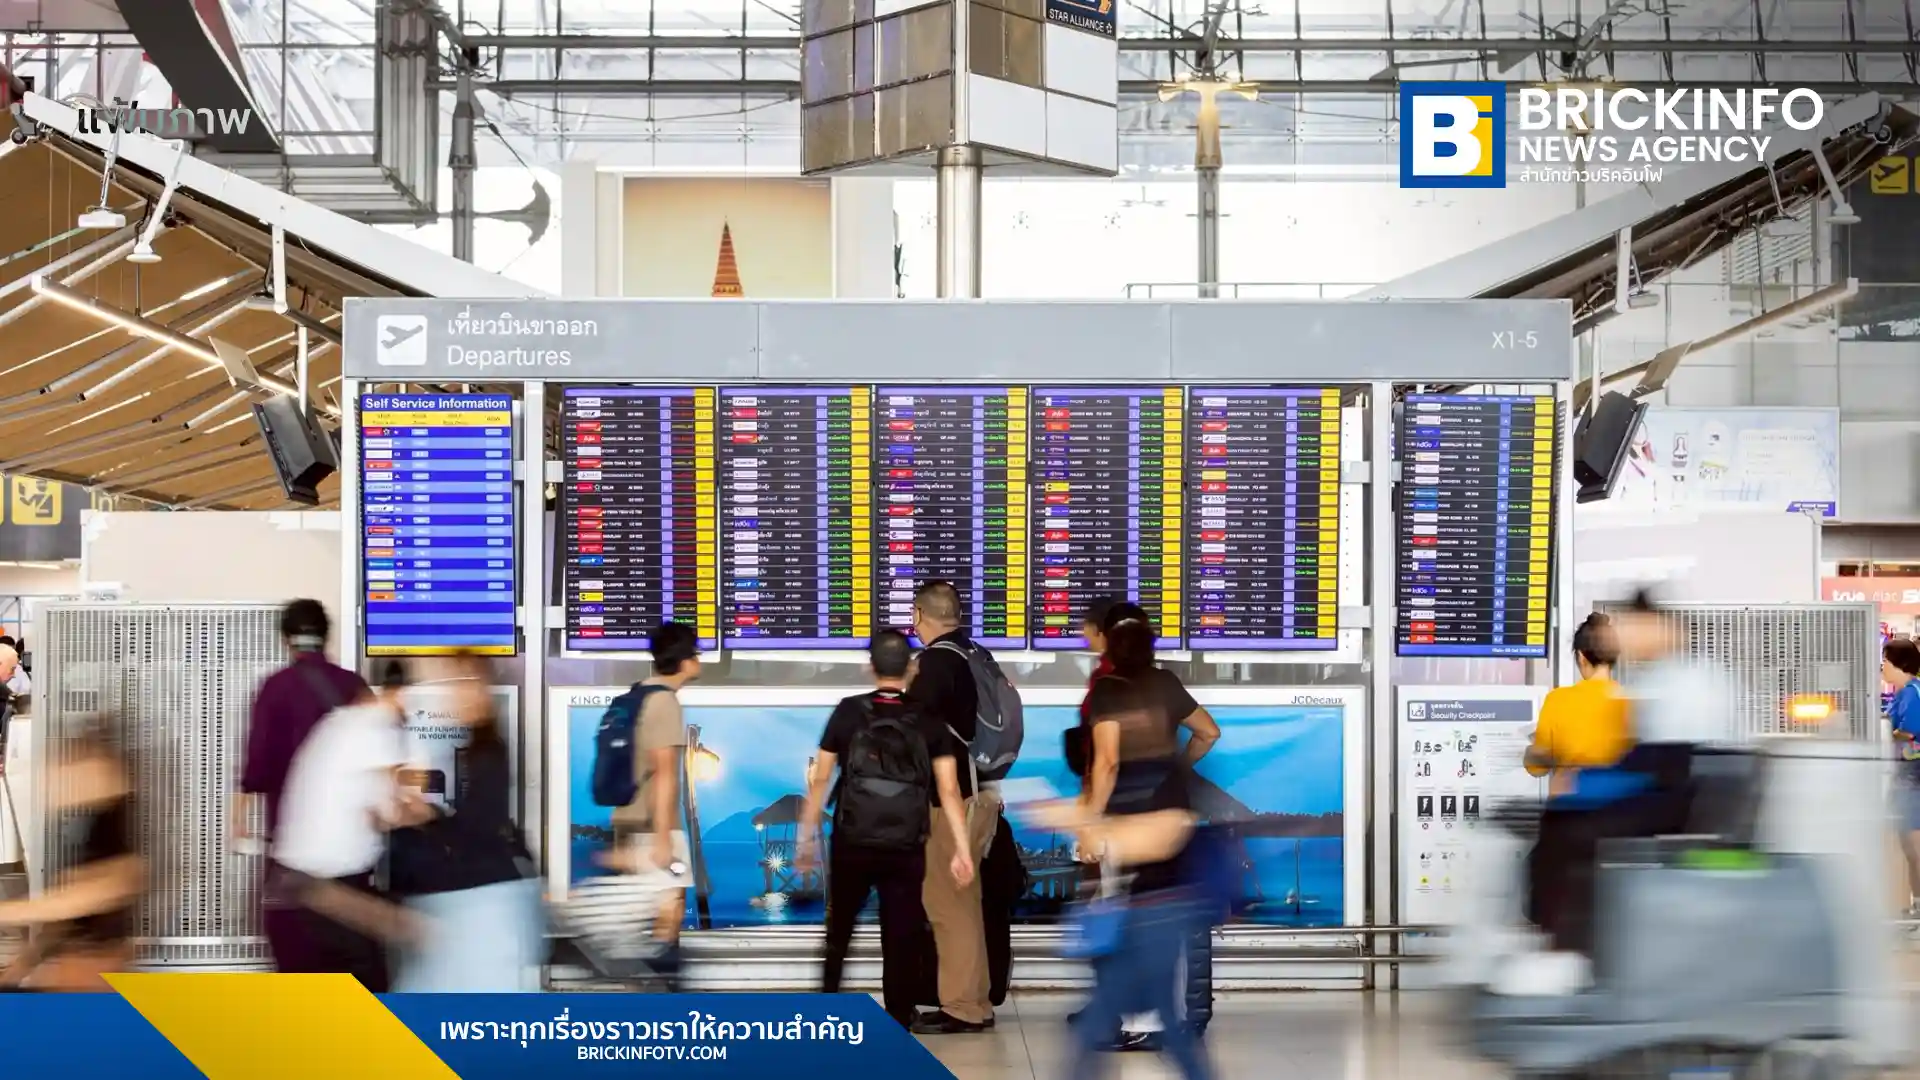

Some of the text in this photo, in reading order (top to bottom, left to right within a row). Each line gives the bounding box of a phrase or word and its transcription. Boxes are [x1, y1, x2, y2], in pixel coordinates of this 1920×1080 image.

[1049, 8, 1104, 32] STAR ALLIANCE
[448, 306, 598, 336] เที่ยวบินขาออก
[1492, 331, 1538, 349] X1-5
[447, 346, 572, 371] Departures
[365, 398, 507, 409] Self Service Information
[1833, 589, 1866, 602] true
[571, 696, 601, 705] KING
[1291, 695, 1344, 705] JCDecaux
[1431, 711, 1496, 720] Security Checkpoint
